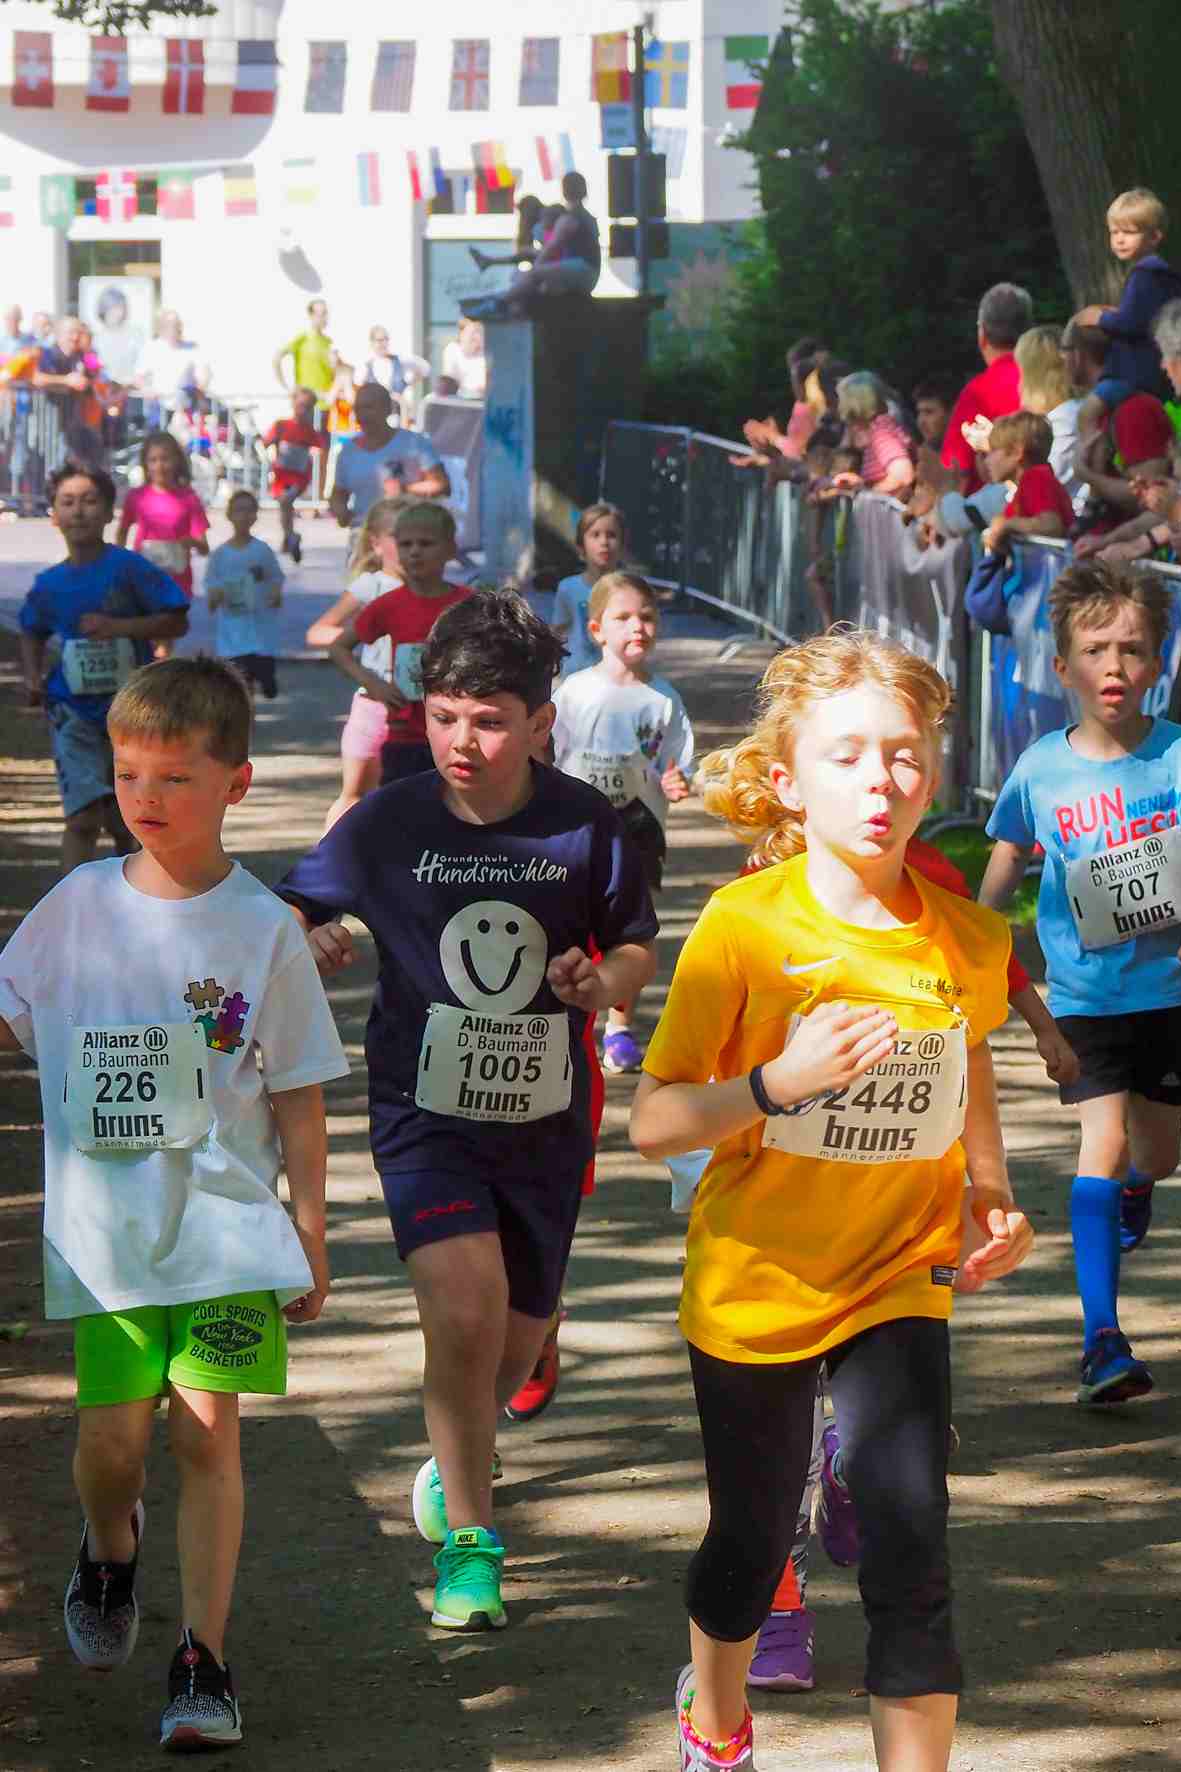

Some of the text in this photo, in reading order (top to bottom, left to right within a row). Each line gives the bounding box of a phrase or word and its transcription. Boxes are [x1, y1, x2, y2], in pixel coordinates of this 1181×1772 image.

[588, 773, 624, 789] 216
[1056, 785, 1126, 844] RUN
[412, 849, 568, 883] Hundsmühlen
[439, 854, 509, 863] Grundschule
[1089, 848, 1142, 873] Allianz
[1092, 855, 1169, 888] D. Baumann
[1108, 871, 1160, 908] 707
[1112, 900, 1176, 935] bruns
[82, 1031, 141, 1050] Allianz
[460, 1015, 524, 1036] Allianz
[457, 1032, 547, 1053] D. Baumann
[82, 1052, 169, 1068] D. Baumann
[459, 1052, 542, 1083] 1005
[862, 1061, 942, 1077] aumann
[95, 1071, 157, 1103] 226
[457, 1081, 532, 1113] bruns
[821, 1080, 933, 1114] 2448
[92, 1106, 165, 1138] bruns
[822, 1114, 918, 1151] bruns
[192, 1303, 267, 1328] COOL SPORTS
[190, 1344, 258, 1367] BASKETBOY
